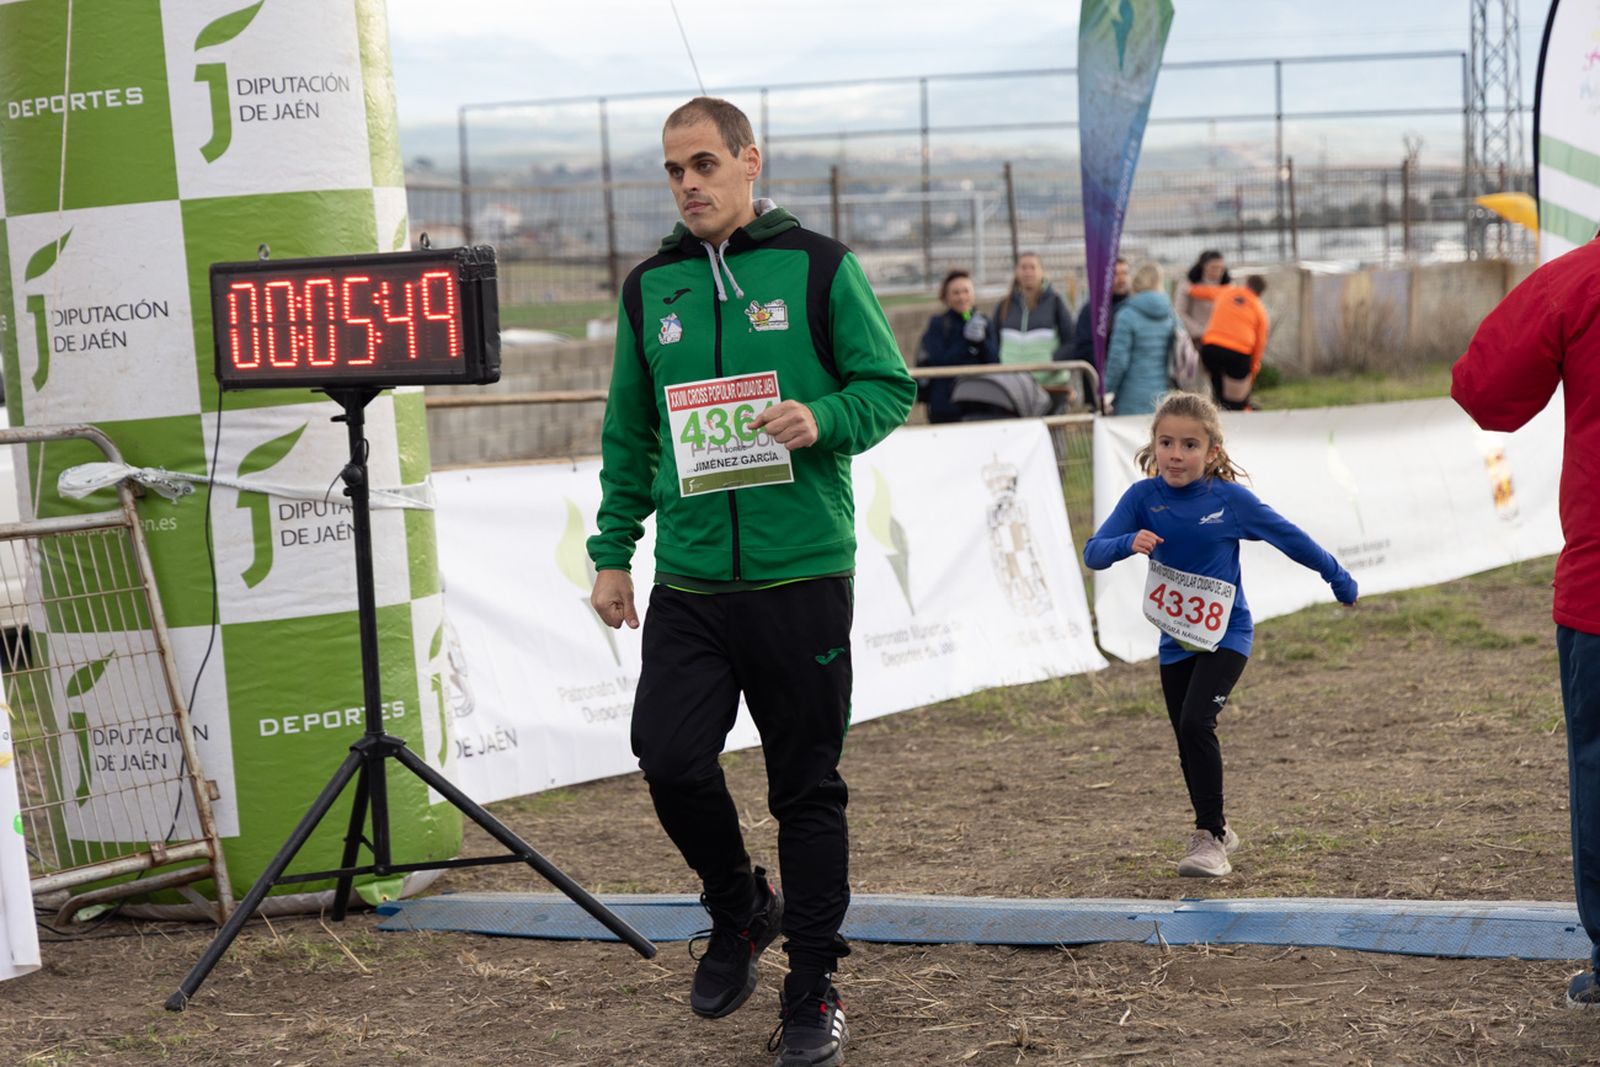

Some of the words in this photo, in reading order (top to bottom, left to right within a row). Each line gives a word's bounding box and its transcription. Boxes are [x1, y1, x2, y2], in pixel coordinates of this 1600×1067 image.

[236, 71, 351, 96] DIPUTACIÓN
[7, 86, 145, 120] DEPORTES
[239, 104, 270, 122] DE
[272, 101, 321, 120] JAÉN
[53, 334, 82, 353] DE
[81, 329, 128, 351] JAÉN
[688, 386, 709, 405] CROSS
[709, 382, 737, 402] POPULAR
[693, 456, 738, 473] JIMÉNEZ
[740, 450, 779, 466] GARCÍA
[278, 501, 354, 521] DIPUTA
[281, 528, 309, 547] DE
[1149, 583, 1224, 632] 4338
[119, 750, 168, 772] JAÉN
